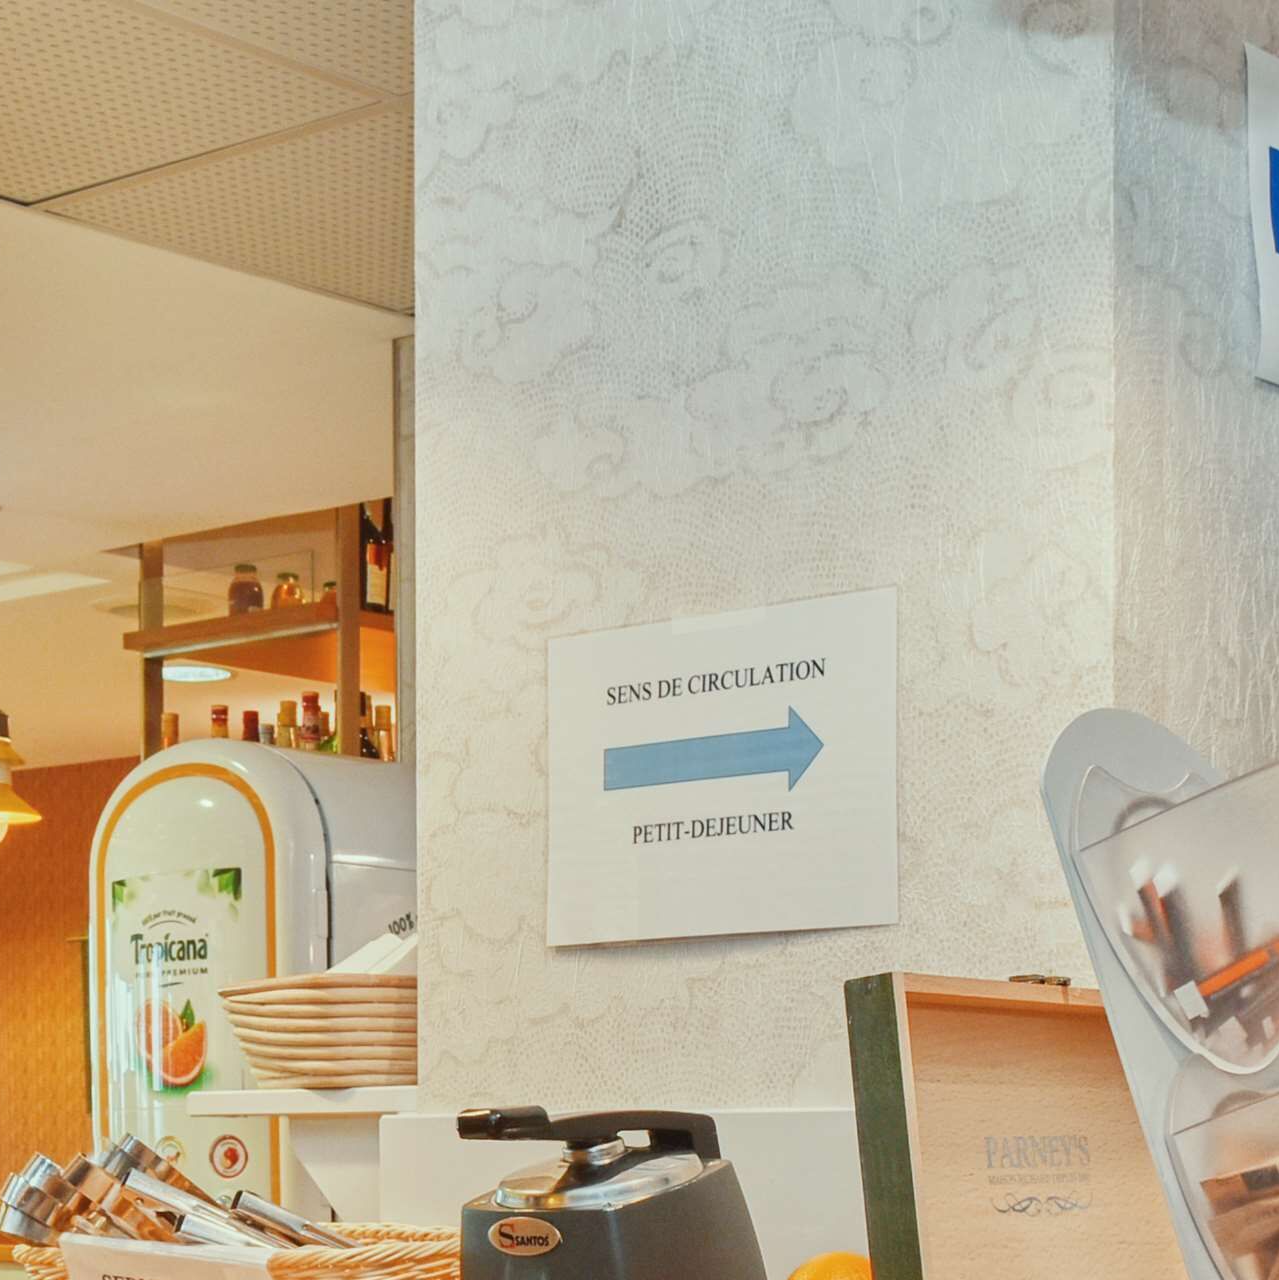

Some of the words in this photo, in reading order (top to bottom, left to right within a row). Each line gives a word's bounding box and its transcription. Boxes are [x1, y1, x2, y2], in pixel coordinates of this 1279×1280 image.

[606, 682, 652, 705] SENS
[658, 678, 683, 699] DE
[688, 658, 826, 695] CIRCULATION
[632, 811, 794, 844] PETIT-DEJEUNER
[515, 1235, 549, 1247] SANTOS
